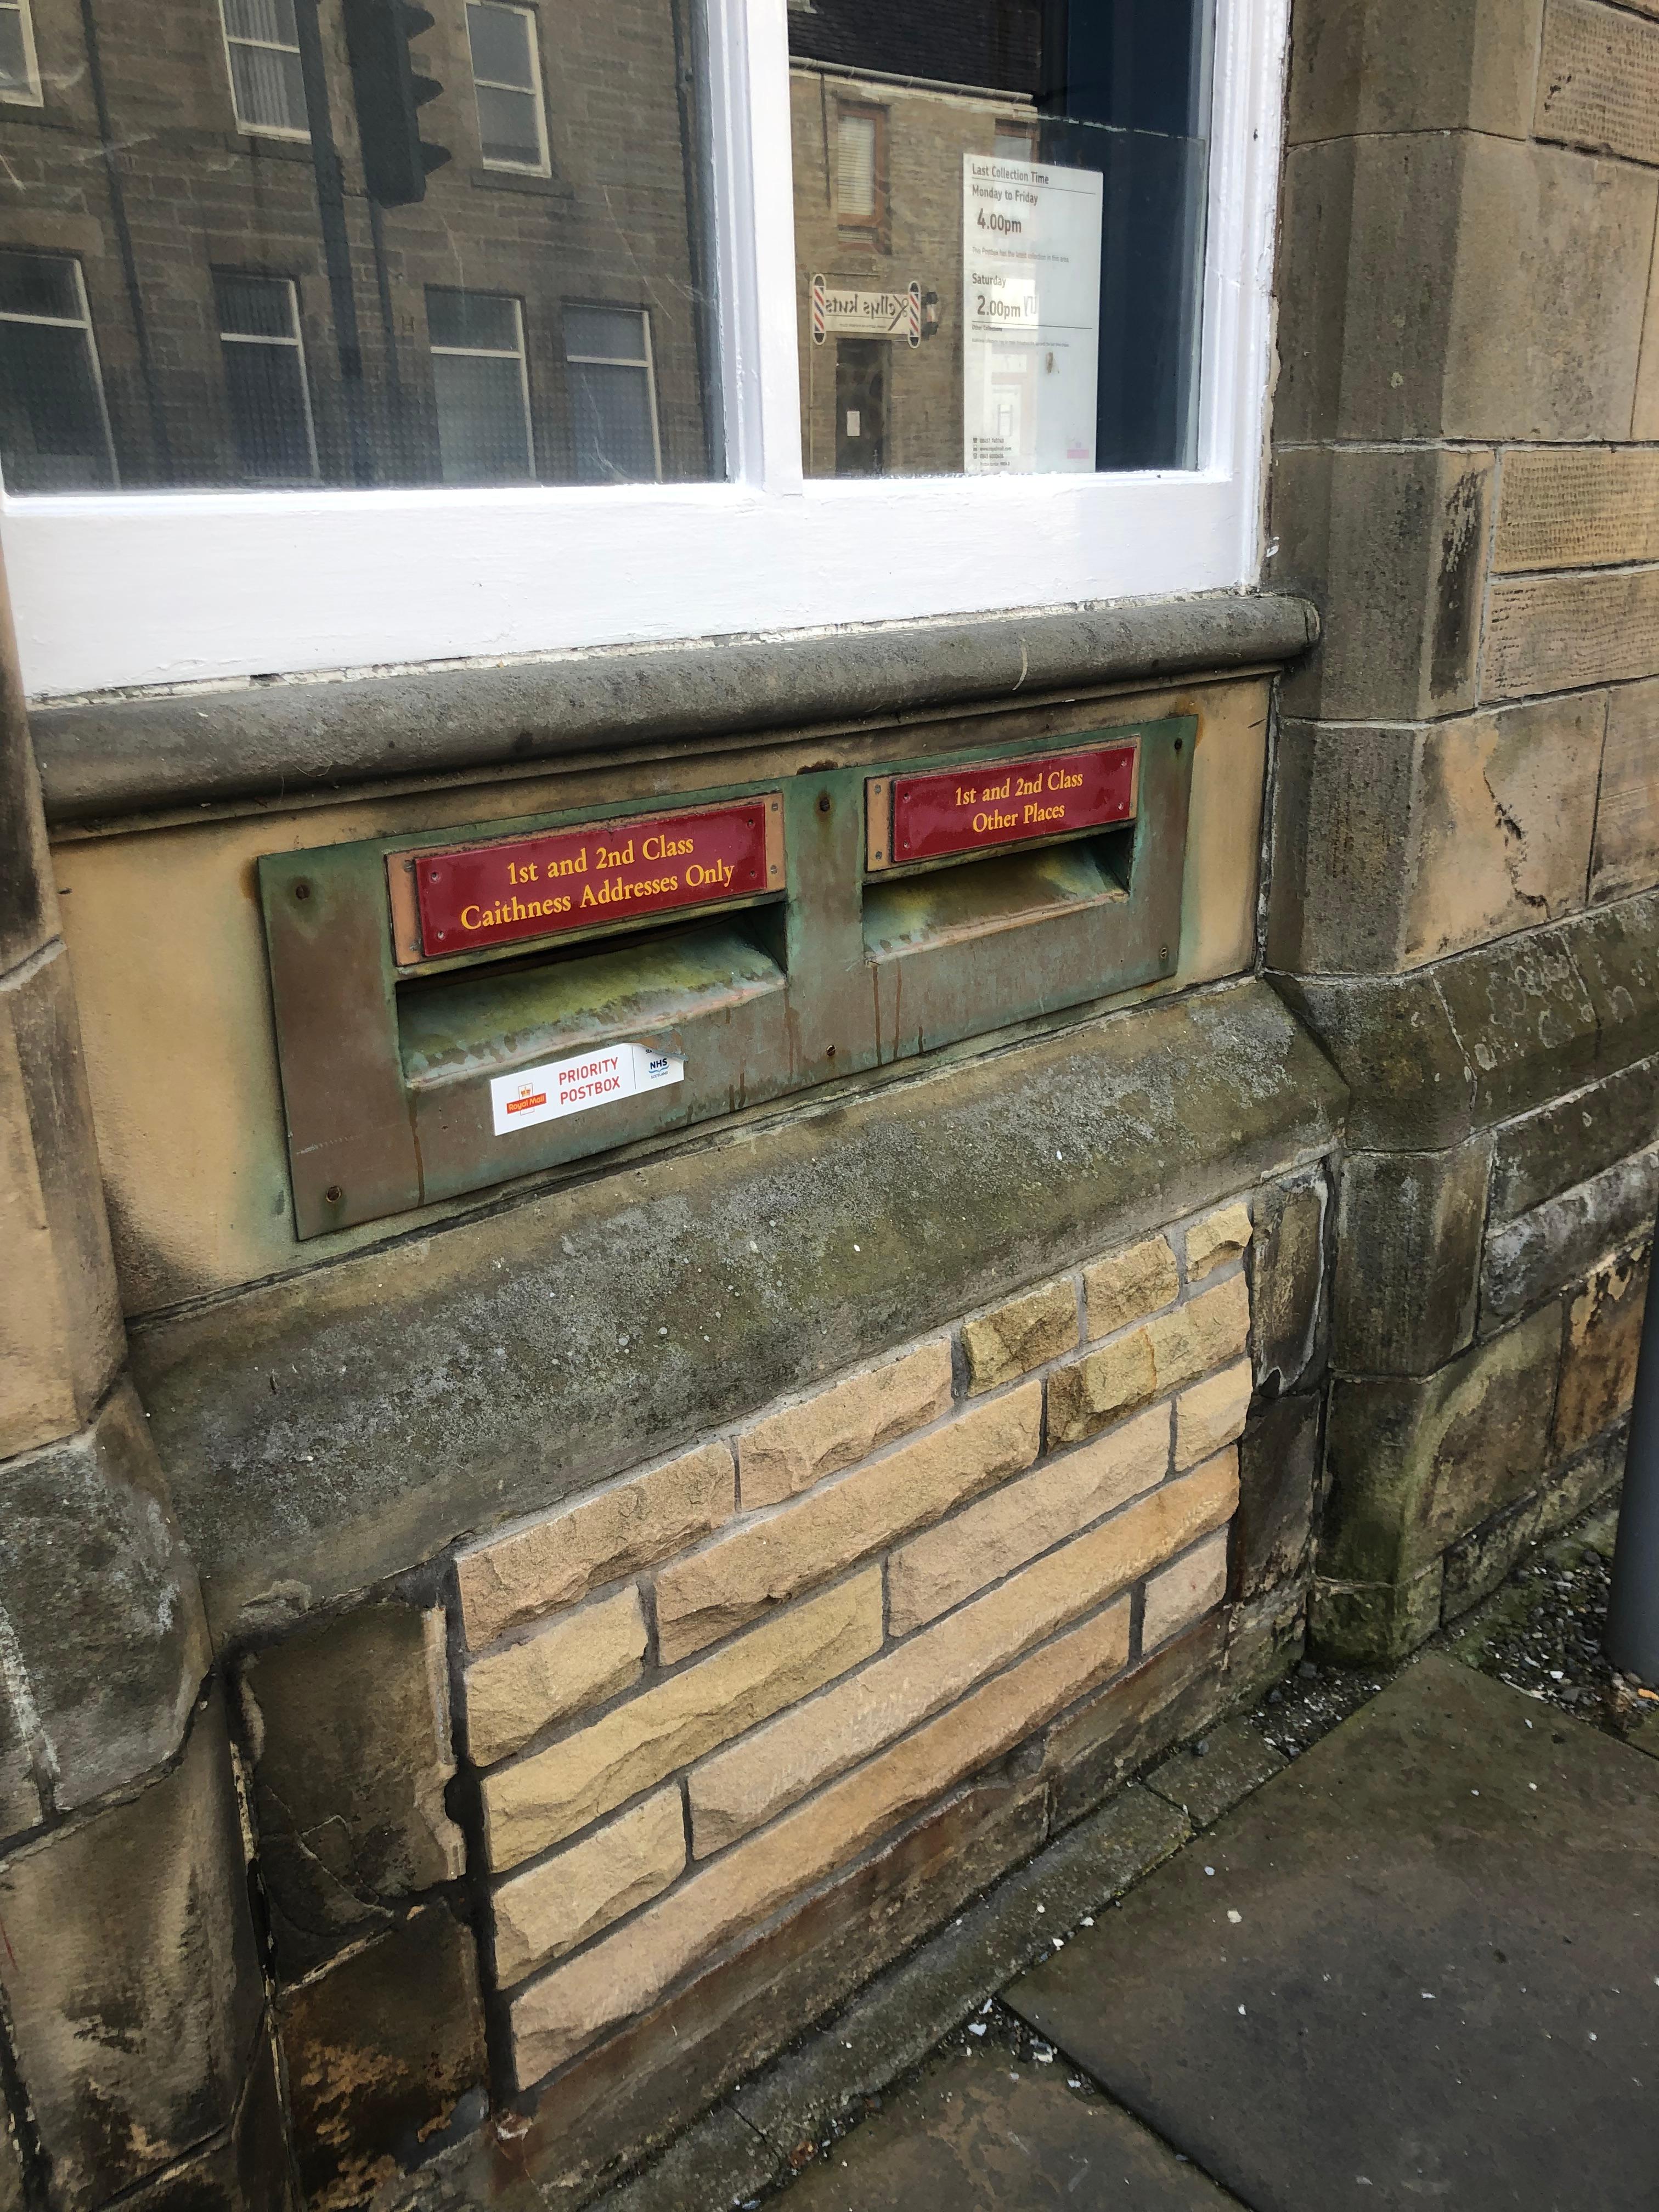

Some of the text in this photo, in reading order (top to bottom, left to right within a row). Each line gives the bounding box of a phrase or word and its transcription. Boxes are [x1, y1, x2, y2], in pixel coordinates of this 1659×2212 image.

[972, 163, 1049, 184] Last Collection Time
[972, 184, 1039, 206] Monday to Friday
[977, 208, 1022, 235] 4.00pm
[972, 273, 1006, 287] Saturday
[977, 295, 1021, 318] 2.00pm
[955, 769, 1084, 806] 1st and 2nd Class
[973, 803, 1065, 833] Other Places
[507, 834, 694, 885] 1st and 2nd Class
[461, 859, 735, 930] Caithness Addresses Only
[558, 1057, 619, 1086] PRIORITY
[650, 1058, 668, 1070] NHS
[650, 1071, 669, 1080] SCOTLAND
[560, 1076, 620, 1105] POSTBOX
[509, 1095, 544, 1112] Royal Mail
